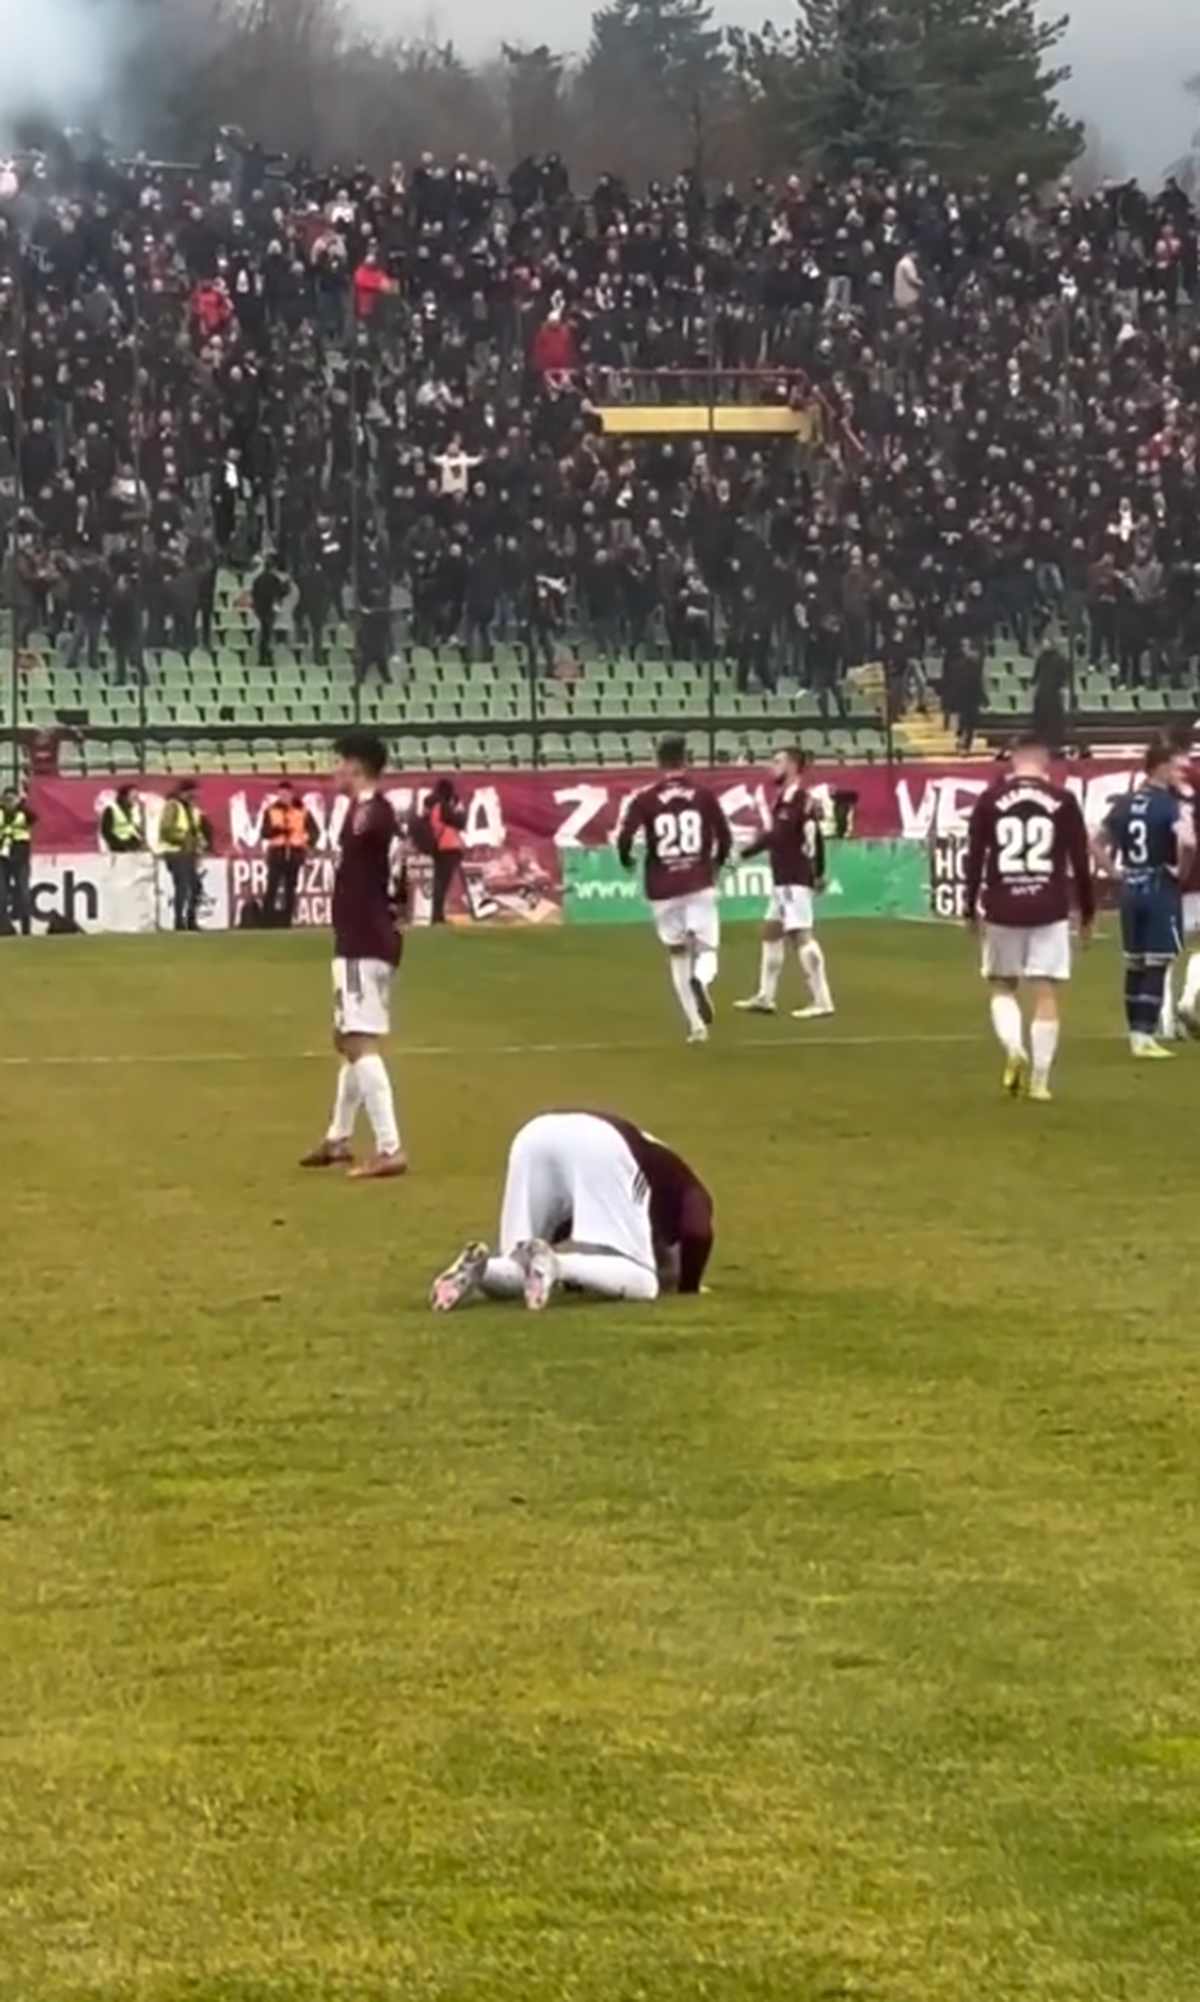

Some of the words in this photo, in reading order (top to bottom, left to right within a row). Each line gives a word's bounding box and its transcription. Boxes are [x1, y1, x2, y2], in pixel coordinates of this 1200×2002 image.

[654, 809, 702, 858] 28
[996, 816, 1054, 873] 22
[1128, 820, 1148, 863] 3
